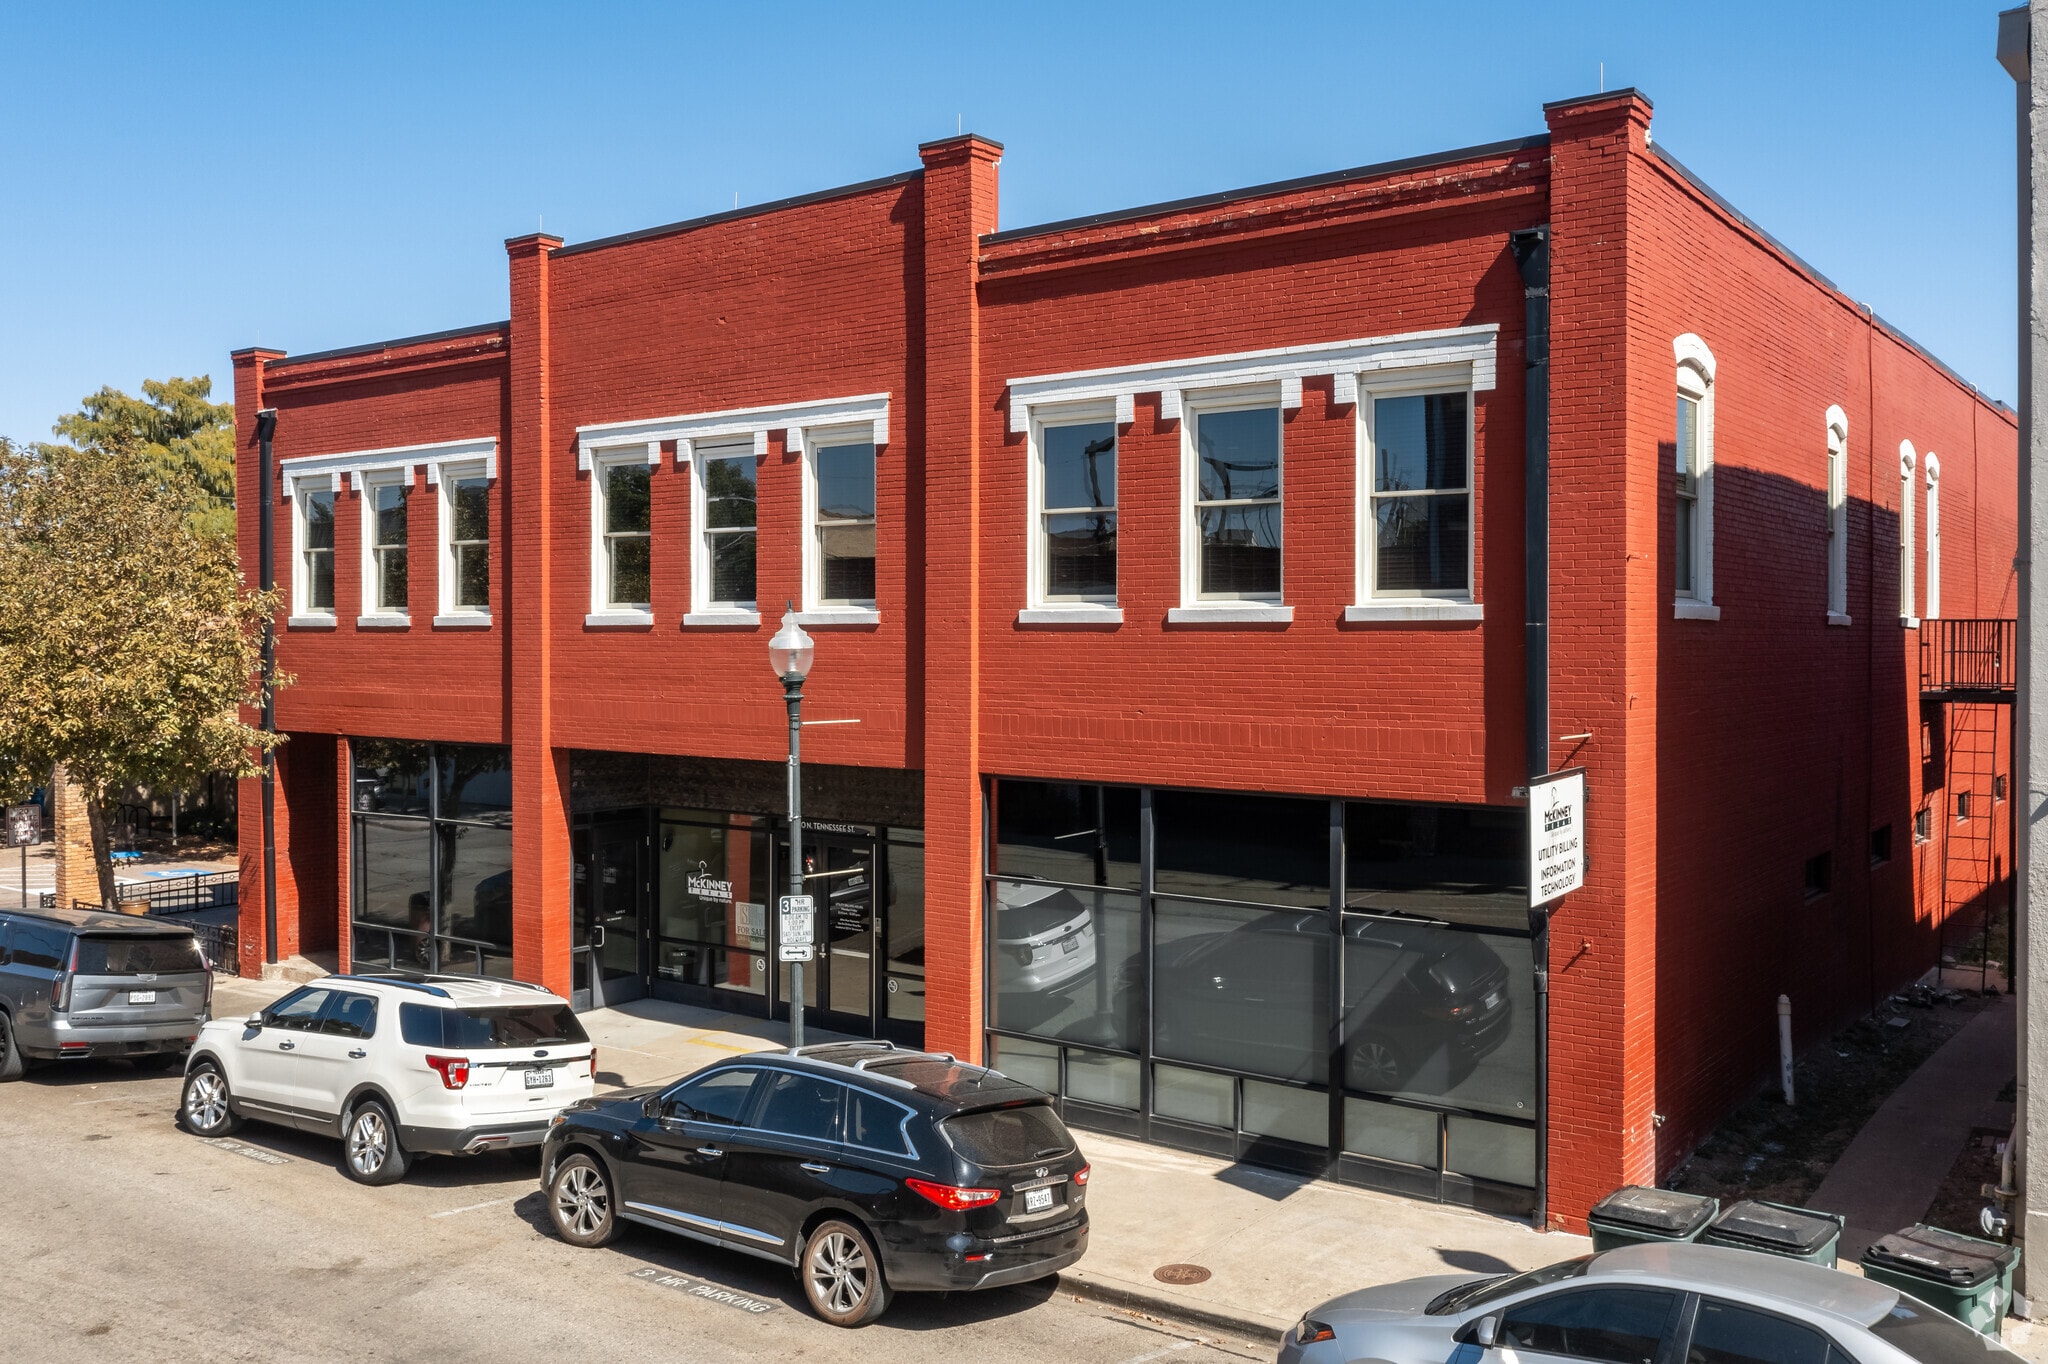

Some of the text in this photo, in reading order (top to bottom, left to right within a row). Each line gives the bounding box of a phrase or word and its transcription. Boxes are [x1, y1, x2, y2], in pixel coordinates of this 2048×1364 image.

[1544, 804, 1572, 823] McKINNEY
[10, 822, 39, 830] LOADING
[813, 822, 847, 832] TENNESSEE
[847, 825, 856, 833] ST.
[1538, 837, 1578, 861] UTILITY BILLING
[1541, 858, 1576, 880] INFORMATION
[687, 875, 733, 891] McKINNEY
[1541, 873, 1576, 897] TECHNOLOGY
[782, 900, 790, 912] 3
[737, 926, 750, 935] FOR
[634, 1269, 771, 1313] 3 HR PARKING
